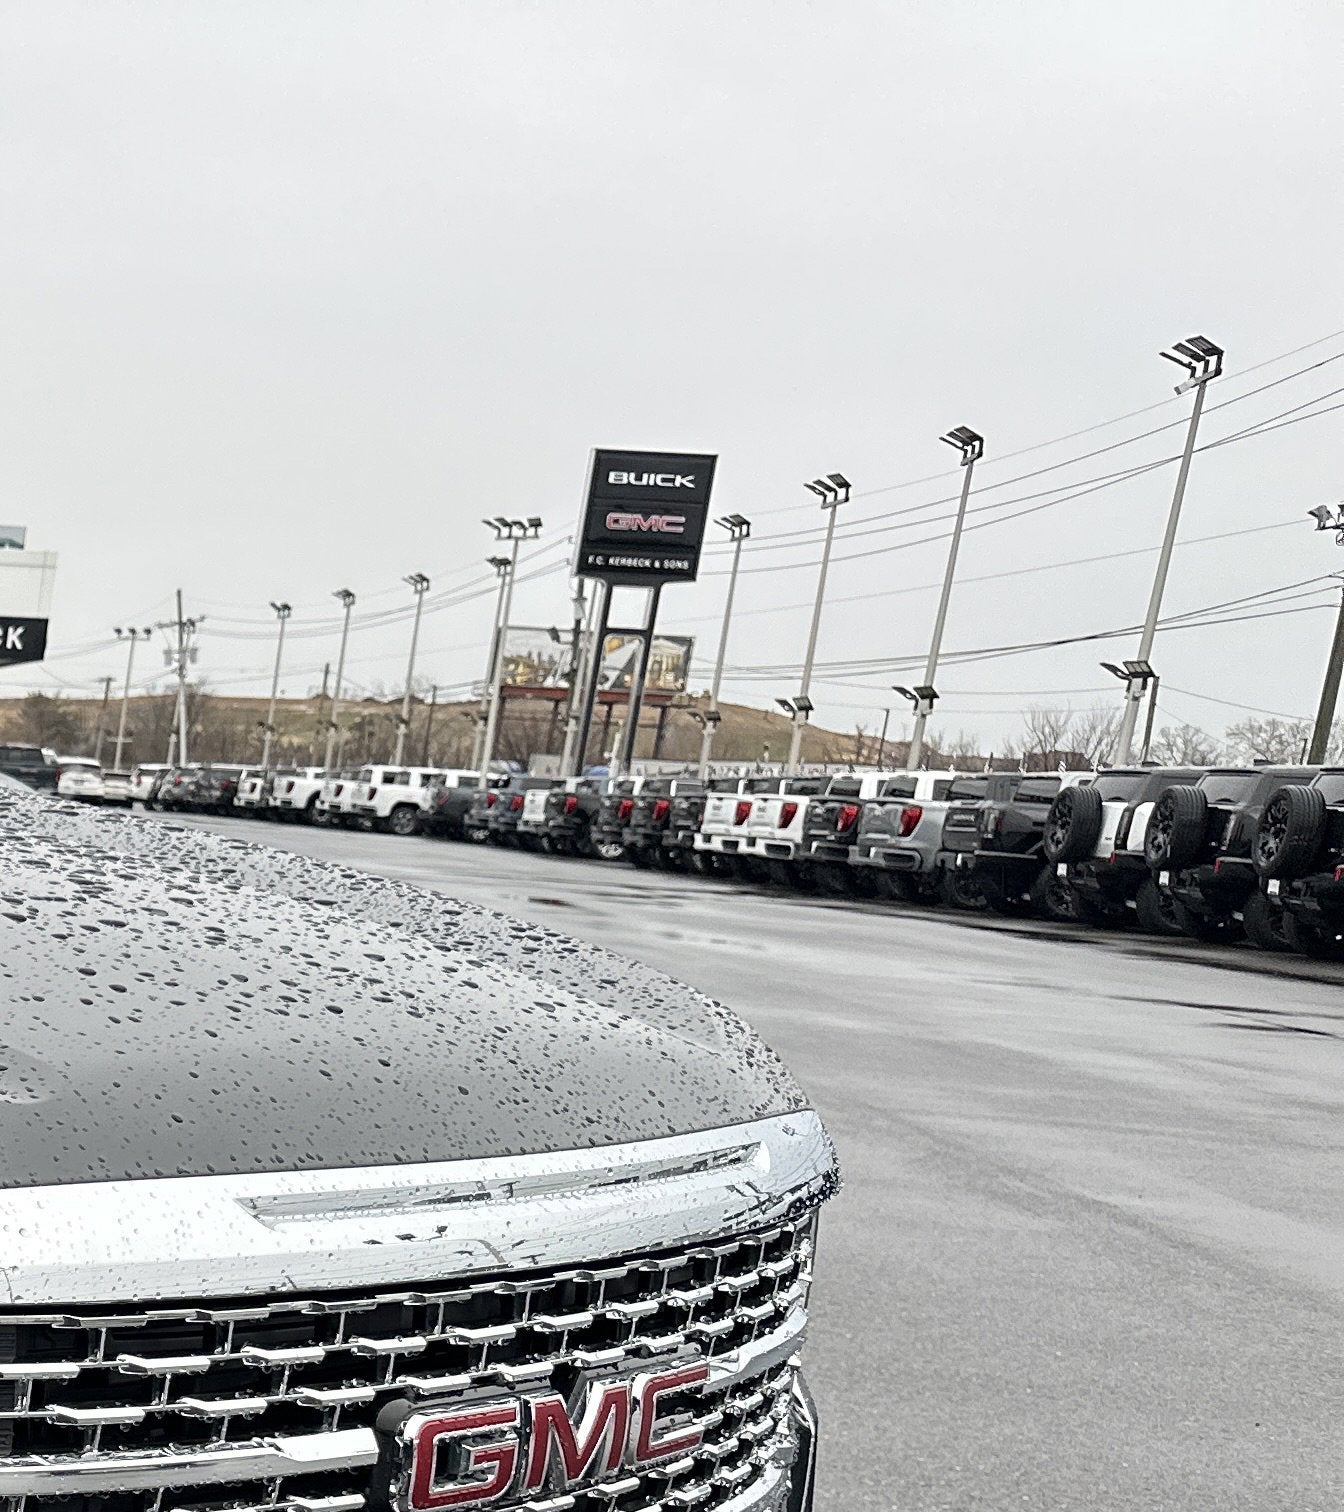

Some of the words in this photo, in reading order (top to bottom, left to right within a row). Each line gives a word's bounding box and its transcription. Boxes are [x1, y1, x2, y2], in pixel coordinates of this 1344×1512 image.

[608, 471, 695, 488] BUICK
[605, 512, 686, 533] GMC
[404, 1360, 712, 1512] GMC
